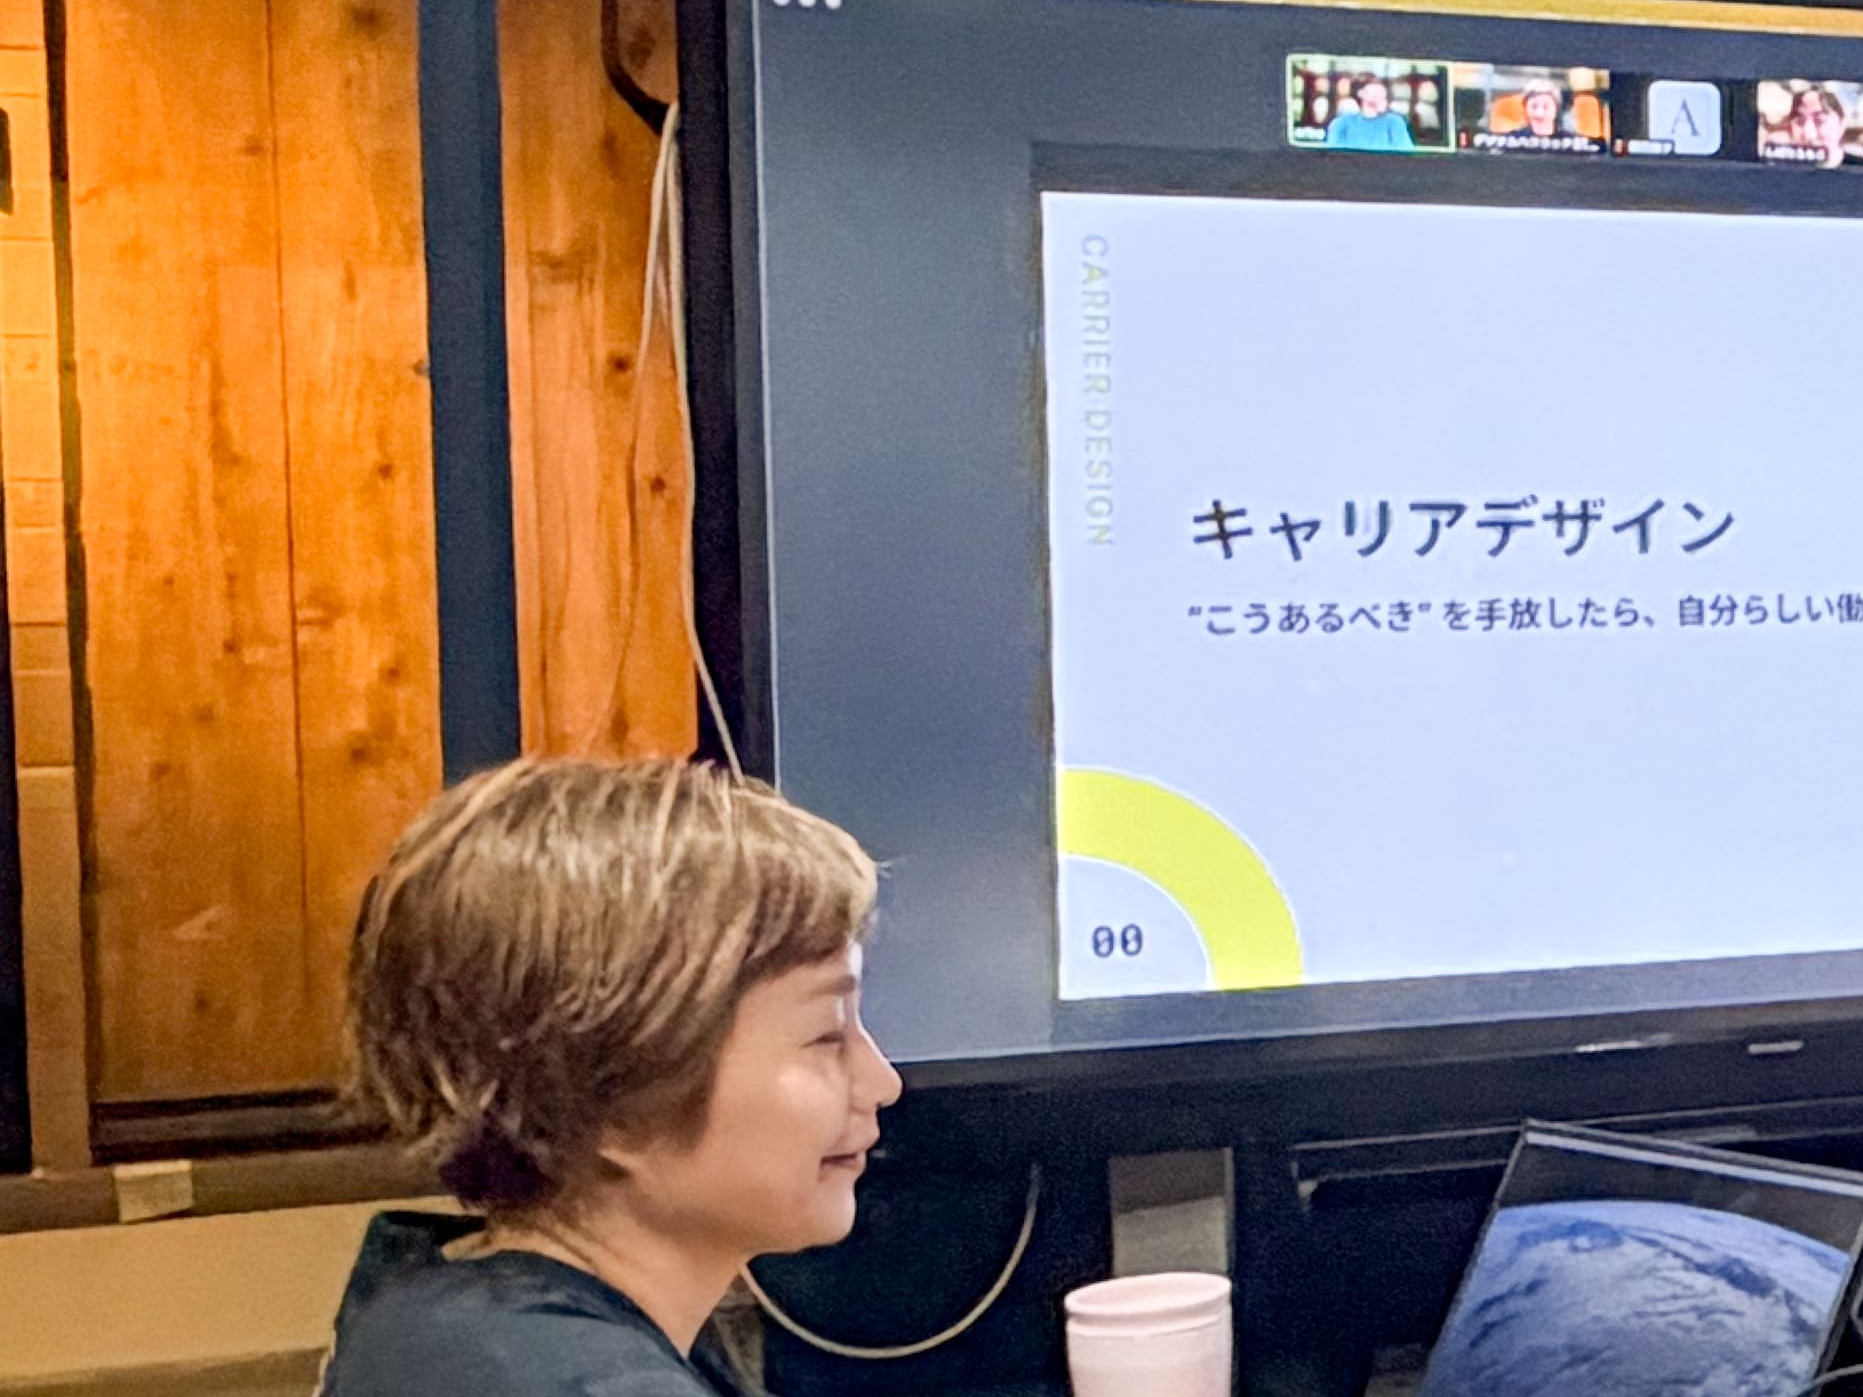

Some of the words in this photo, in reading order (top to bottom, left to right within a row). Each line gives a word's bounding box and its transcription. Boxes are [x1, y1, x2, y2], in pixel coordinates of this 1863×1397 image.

[1081, 234, 1113, 395] CARRIER
[1085, 410, 1115, 547] DESIGN
[1192, 495, 1737, 564] キャリアデザイン
[1092, 923, 1144, 959] 00
